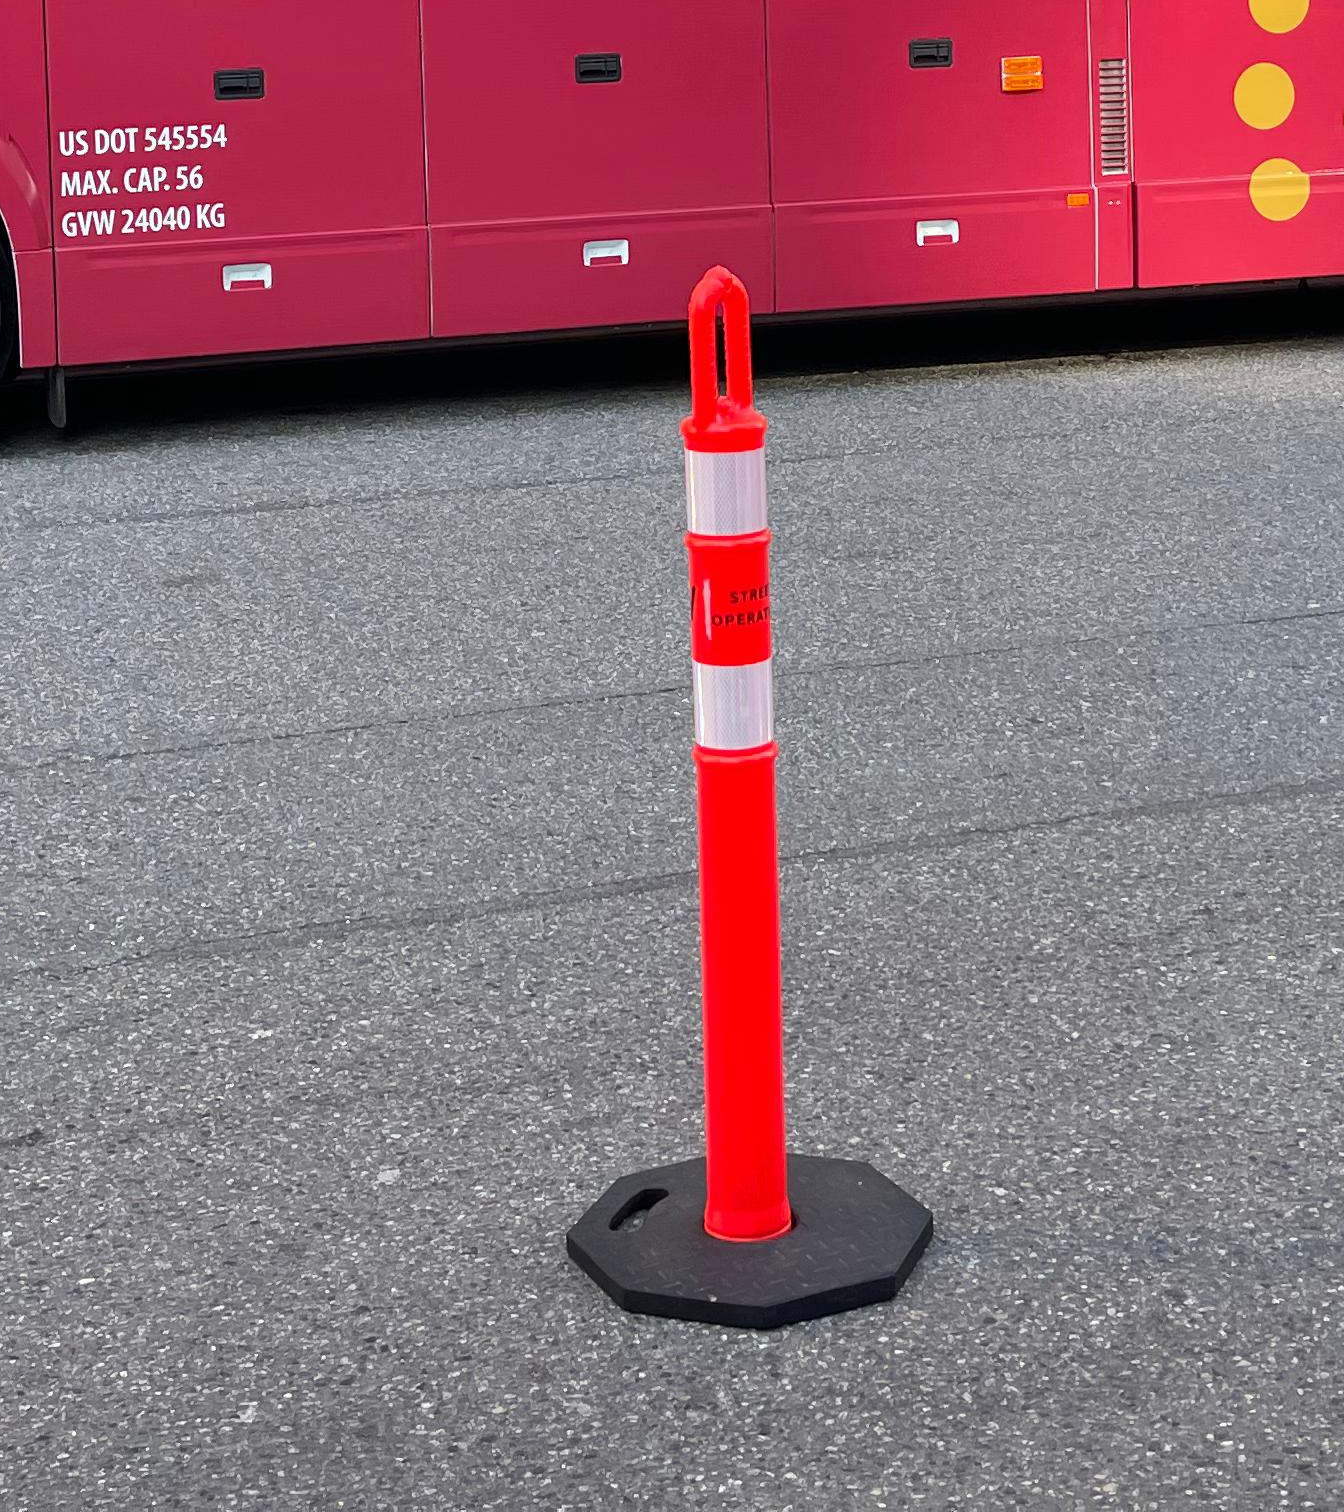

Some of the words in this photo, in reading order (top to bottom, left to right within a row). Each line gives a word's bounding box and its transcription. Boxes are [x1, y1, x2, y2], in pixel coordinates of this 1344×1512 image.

[59, 129, 89, 157] US
[94, 127, 139, 155] DOT
[144, 123, 228, 152] 545554
[60, 169, 119, 197] MAX.
[123, 166, 171, 193] CAP.
[175, 164, 204, 191] 56
[61, 208, 116, 238] GVW
[121, 205, 191, 234] 24040
[196, 202, 226, 230] KG
